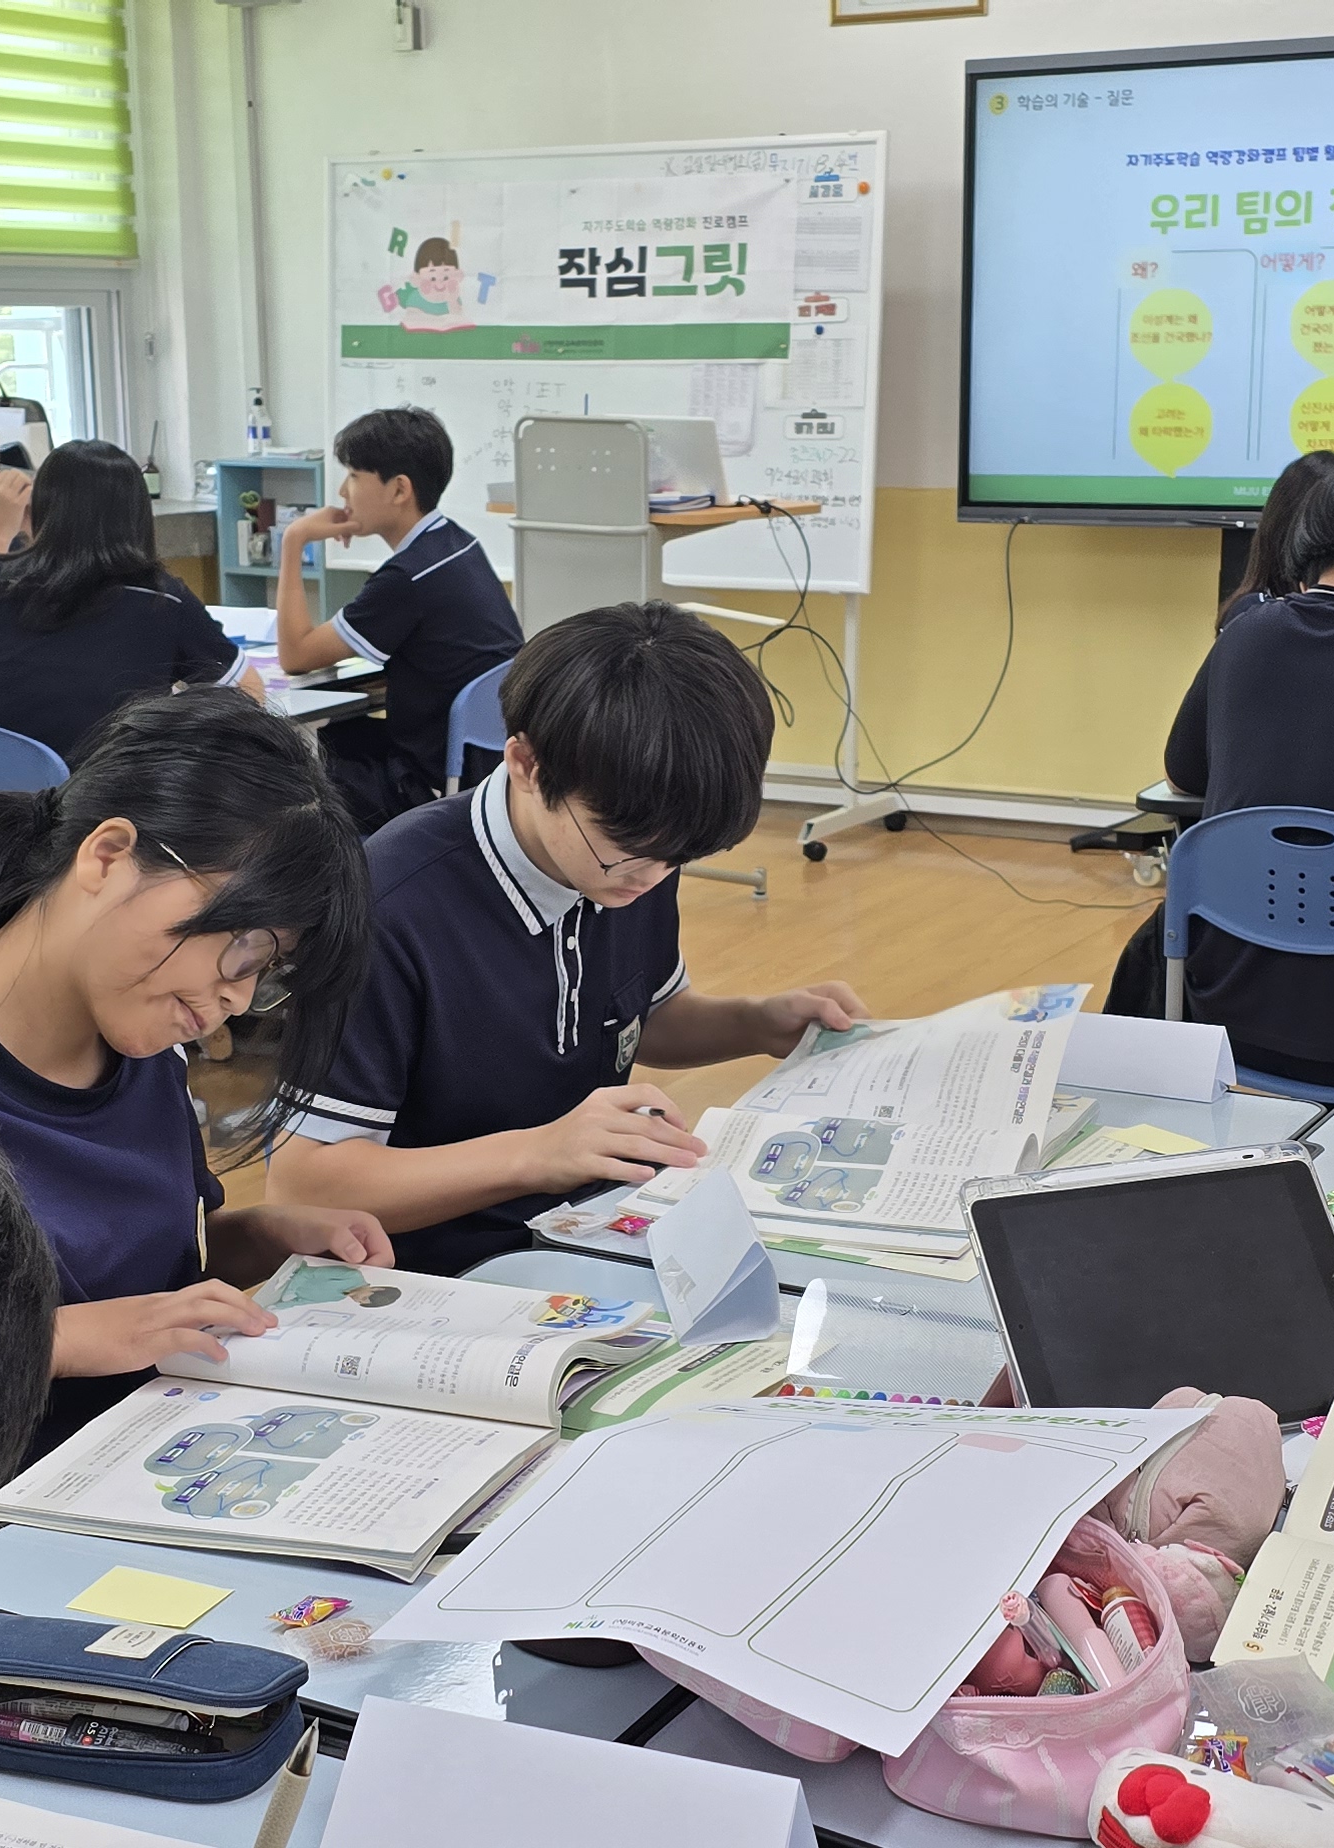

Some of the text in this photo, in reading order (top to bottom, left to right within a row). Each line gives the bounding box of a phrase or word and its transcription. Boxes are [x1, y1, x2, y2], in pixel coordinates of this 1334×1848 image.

[995, 95, 1005, 110] 3
[1017, 93, 1058, 111] 학습의
[1063, 92, 1089, 108] 기술
[1107, 89, 1135, 107] 질문
[1126, 151, 1201, 168] 자기주도학습
[1206, 147, 1287, 167] 역량강화캠프
[1149, 194, 1219, 235] 우리
[1235, 189, 1313, 235] 팀의
[582, 215, 749, 233] 자기주도학습 역량강화 진로캠프
[558, 242, 747, 299] 작심그릿
[1131, 261, 1159, 279] 왜?
[1260, 252, 1325, 273] 어떻게?
[1300, 323, 1332, 335] 건국이
[1298, 421, 1330, 432] 어떻게
[1267, 1587, 1285, 1601] 질문
[1257, 1603, 1278, 1621] 기술2
[1250, 1619, 1272, 1640] 학습의
[1244, 1642, 1262, 1650] 5
